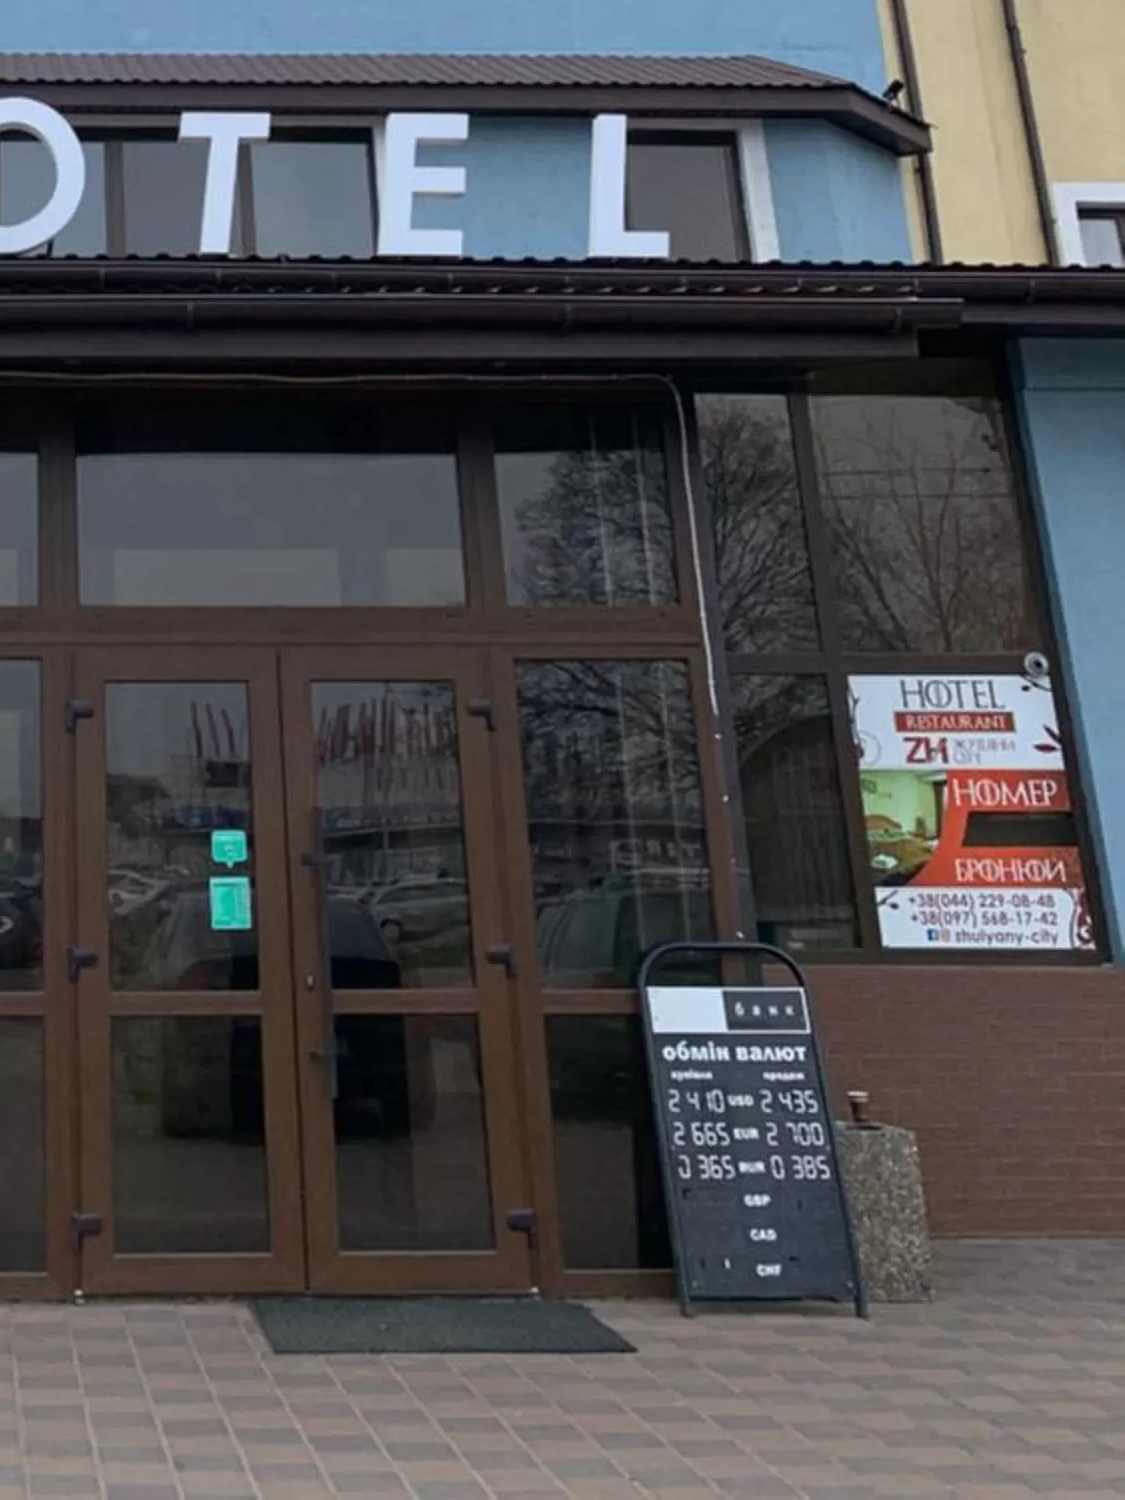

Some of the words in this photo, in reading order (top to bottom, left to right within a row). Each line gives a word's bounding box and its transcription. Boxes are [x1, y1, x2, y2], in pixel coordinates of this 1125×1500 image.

[899, 679, 1006, 709] HOTEL
[906, 714, 1006, 730] RESTAURANT
[953, 778, 1058, 807] НОМЕР
[954, 856, 1067, 882] БРОНЮЙ
[662, 1040, 730, 1062] обмін
[735, 1046, 807, 1062] валют
[733, 1127, 760, 1140] EUR
[750, 1228, 777, 1242] CAD
